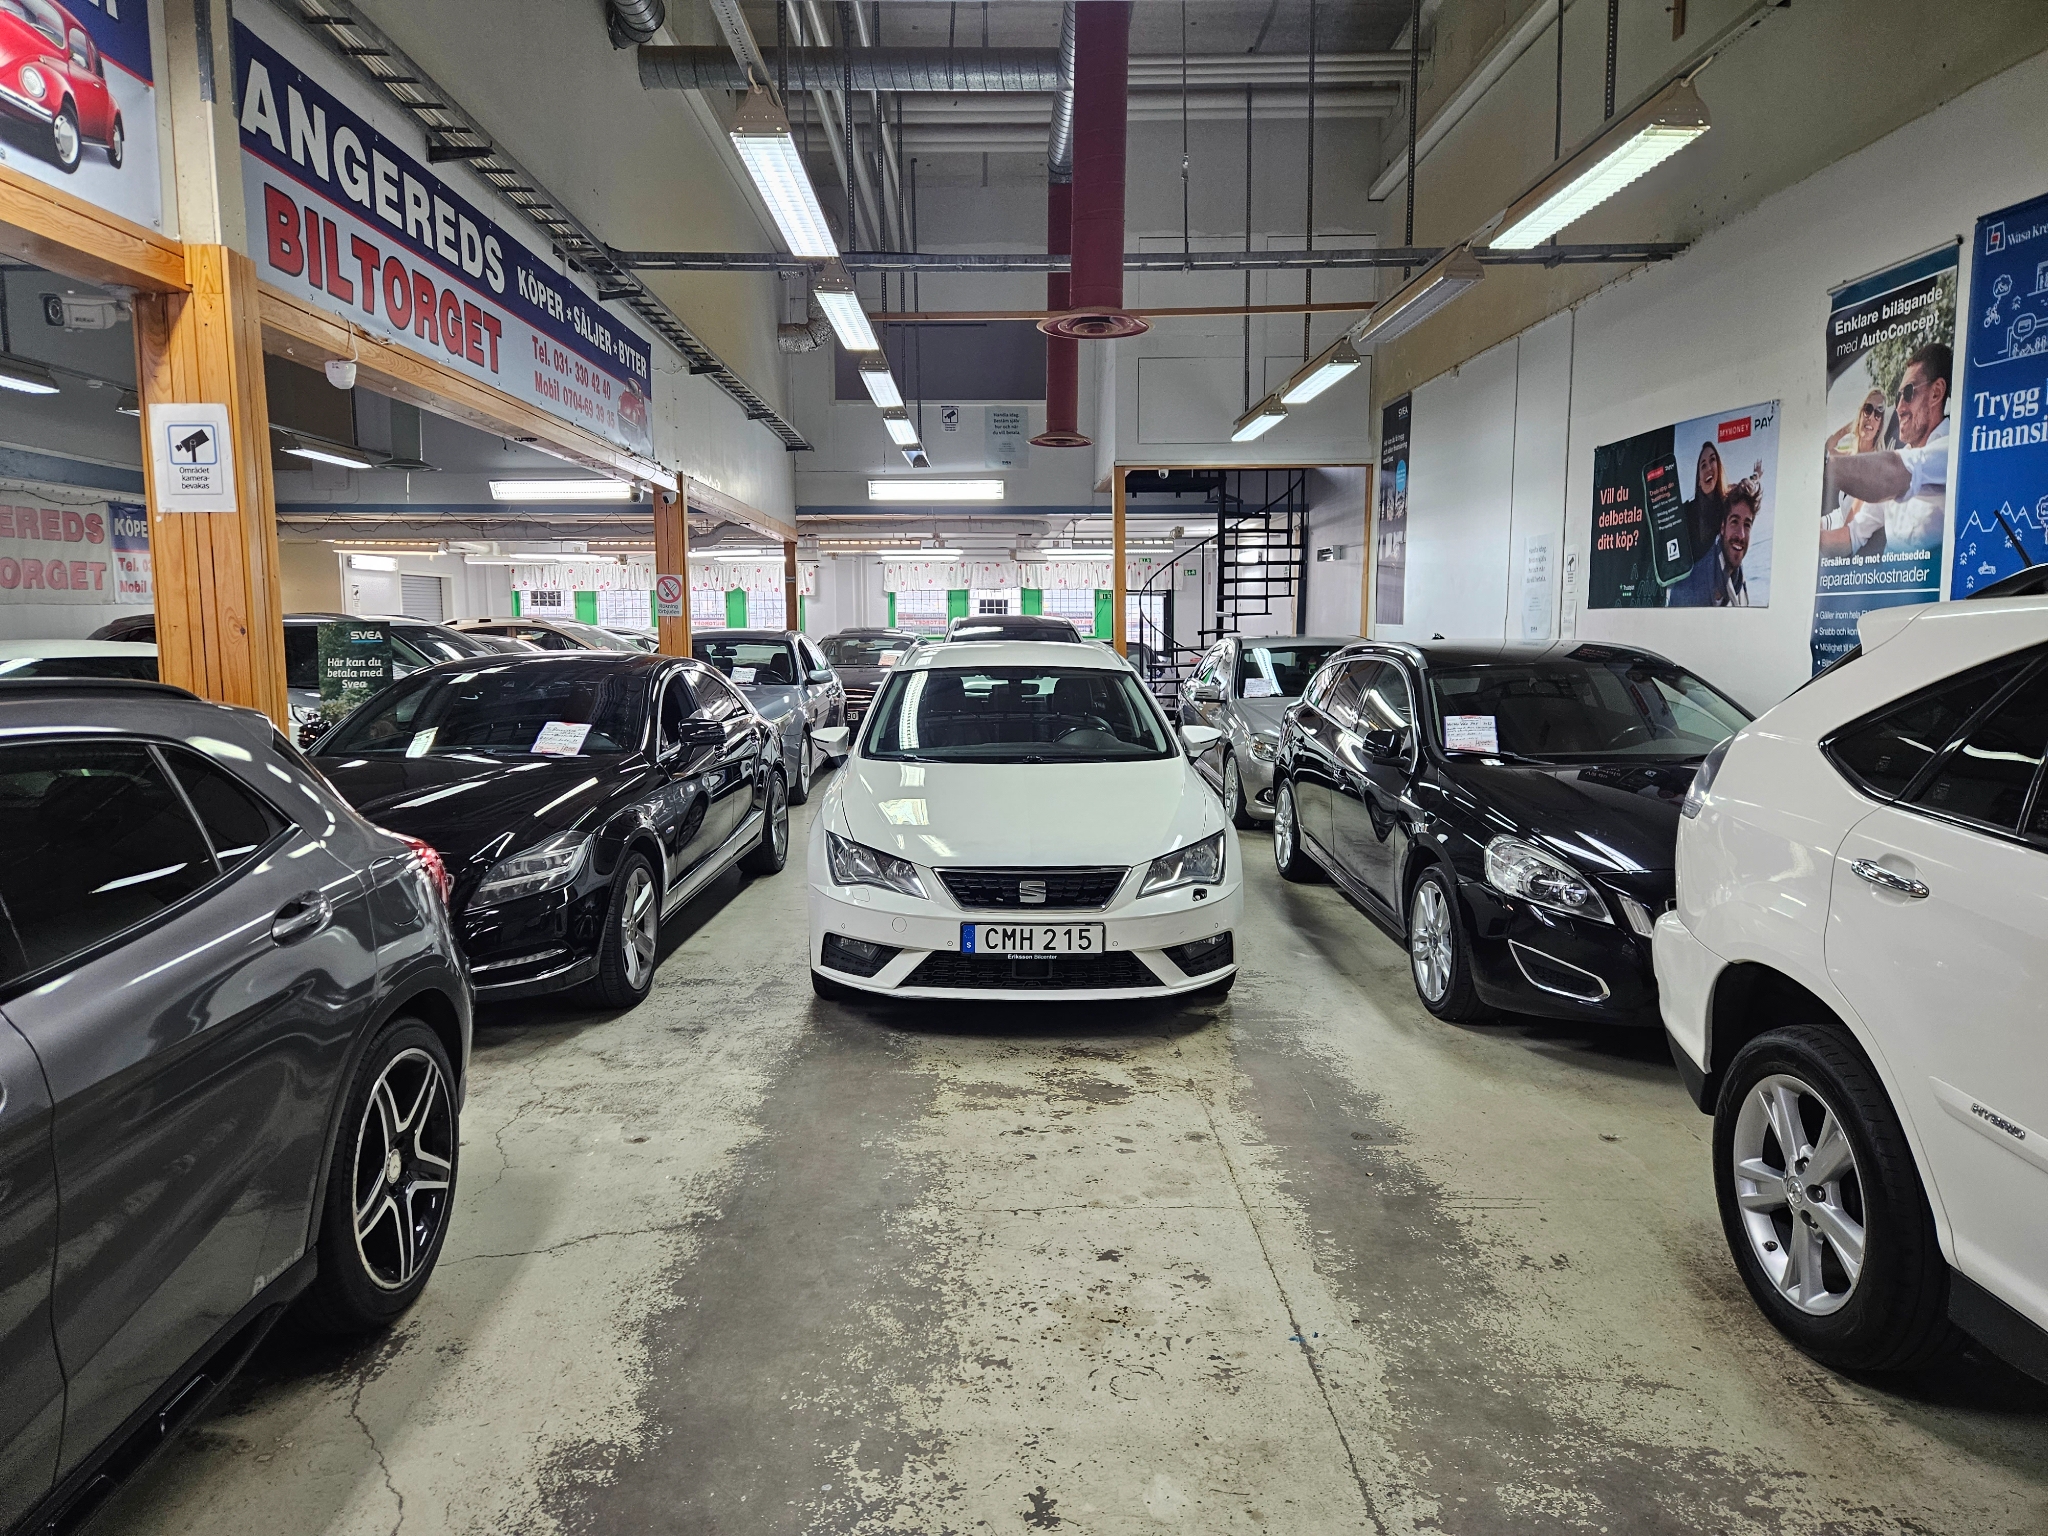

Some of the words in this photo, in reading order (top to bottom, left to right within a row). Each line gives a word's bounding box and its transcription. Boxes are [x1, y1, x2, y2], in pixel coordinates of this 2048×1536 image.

[240, 58, 505, 294] ANGEREDS
[2008, 230, 2030, 246] Wasa
[264, 182, 502, 375] BILTORGET
[517, 265, 565, 324] KÖPER
[573, 305, 612, 356] SÄLJER
[618, 339, 647, 379] BYTER
[1835, 311, 1879, 336] Enklare
[1882, 286, 1943, 320] bilägande
[1836, 337, 1858, 357] med
[1860, 309, 1940, 349] AutoConcept
[532, 335, 550, 362] Tel.
[554, 350, 572, 376] 031-
[574, 362, 588, 388] 330
[592, 372, 600, 394] 42
[602, 379, 610, 400] 40
[534, 371, 560, 402] Mobil
[563, 387, 594, 418] 0704-69
[1974, 387, 2041, 421] Trygg
[1719, 423, 1750, 438] MYMONEY
[1754, 415, 1774, 431] PAY
[1600, 487, 1614, 505] Vill
[1617, 486, 1629, 502] du
[1598, 506, 1642, 528] delbetala
[1597, 534, 1614, 550] ditt
[1615, 530, 1640, 551] köp?
[118, 558, 139, 572] Tel.
[1821, 556, 1850, 567] Försäkra
[1852, 555, 1864, 566] dig
[1865, 554, 1880, 564] mot
[1882, 549, 1931, 563] oförutsedda
[120, 581, 146, 592] Mobil
[1820, 566, 1930, 589] reparationskostnader
[350, 631, 383, 640] SVEA
[1820, 627, 1835, 636] Snabb
[1837, 627, 1846, 636] och
[327, 658, 344, 667] Här
[346, 658, 366, 667] kan
[368, 657, 382, 666] du
[327, 668, 358, 678] betala
[360, 668, 384, 677] med
[342, 680, 368, 688] Svea
[985, 928, 1034, 950] CMH
[1043, 928, 1092, 950] 215
